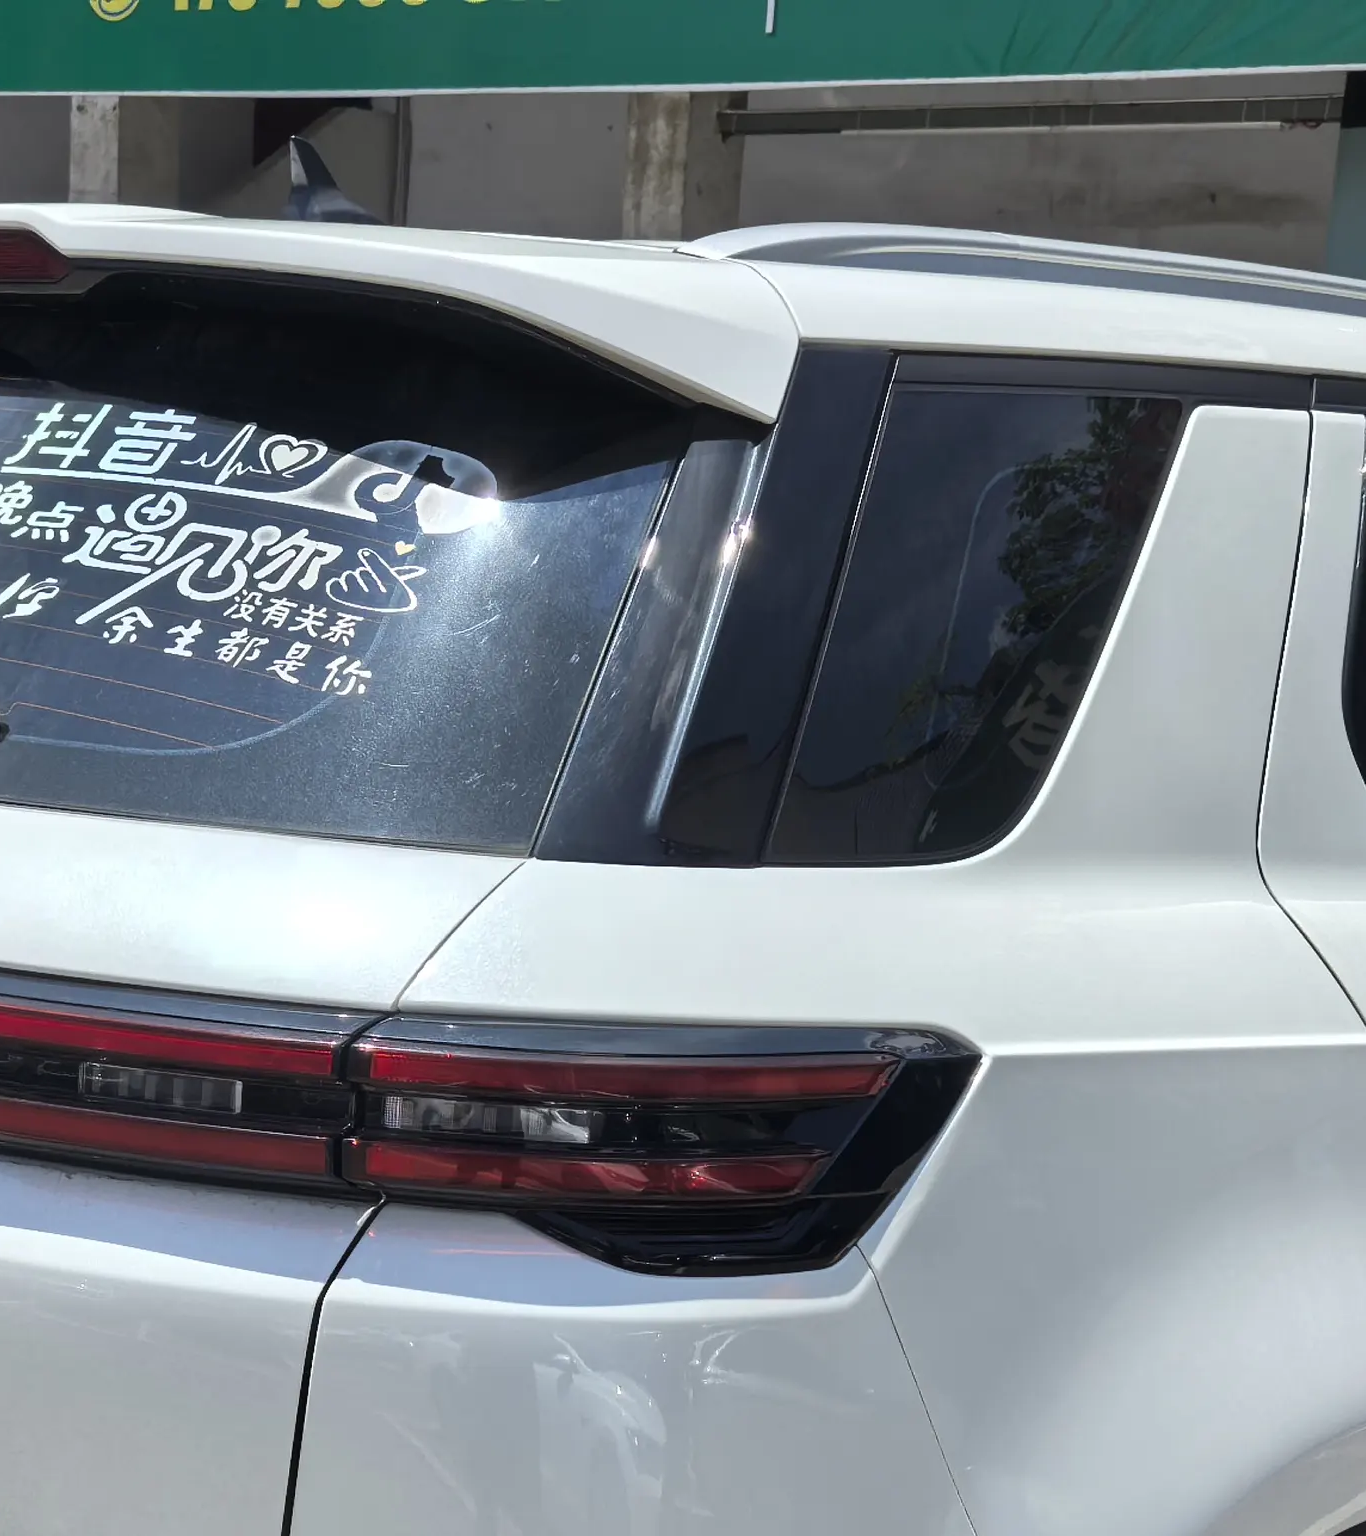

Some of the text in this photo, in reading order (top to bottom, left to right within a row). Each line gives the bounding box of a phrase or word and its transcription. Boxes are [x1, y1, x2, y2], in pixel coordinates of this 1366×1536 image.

[1, 402, 197, 474] 抖音
[223, 590, 357, 647] 没有关系
